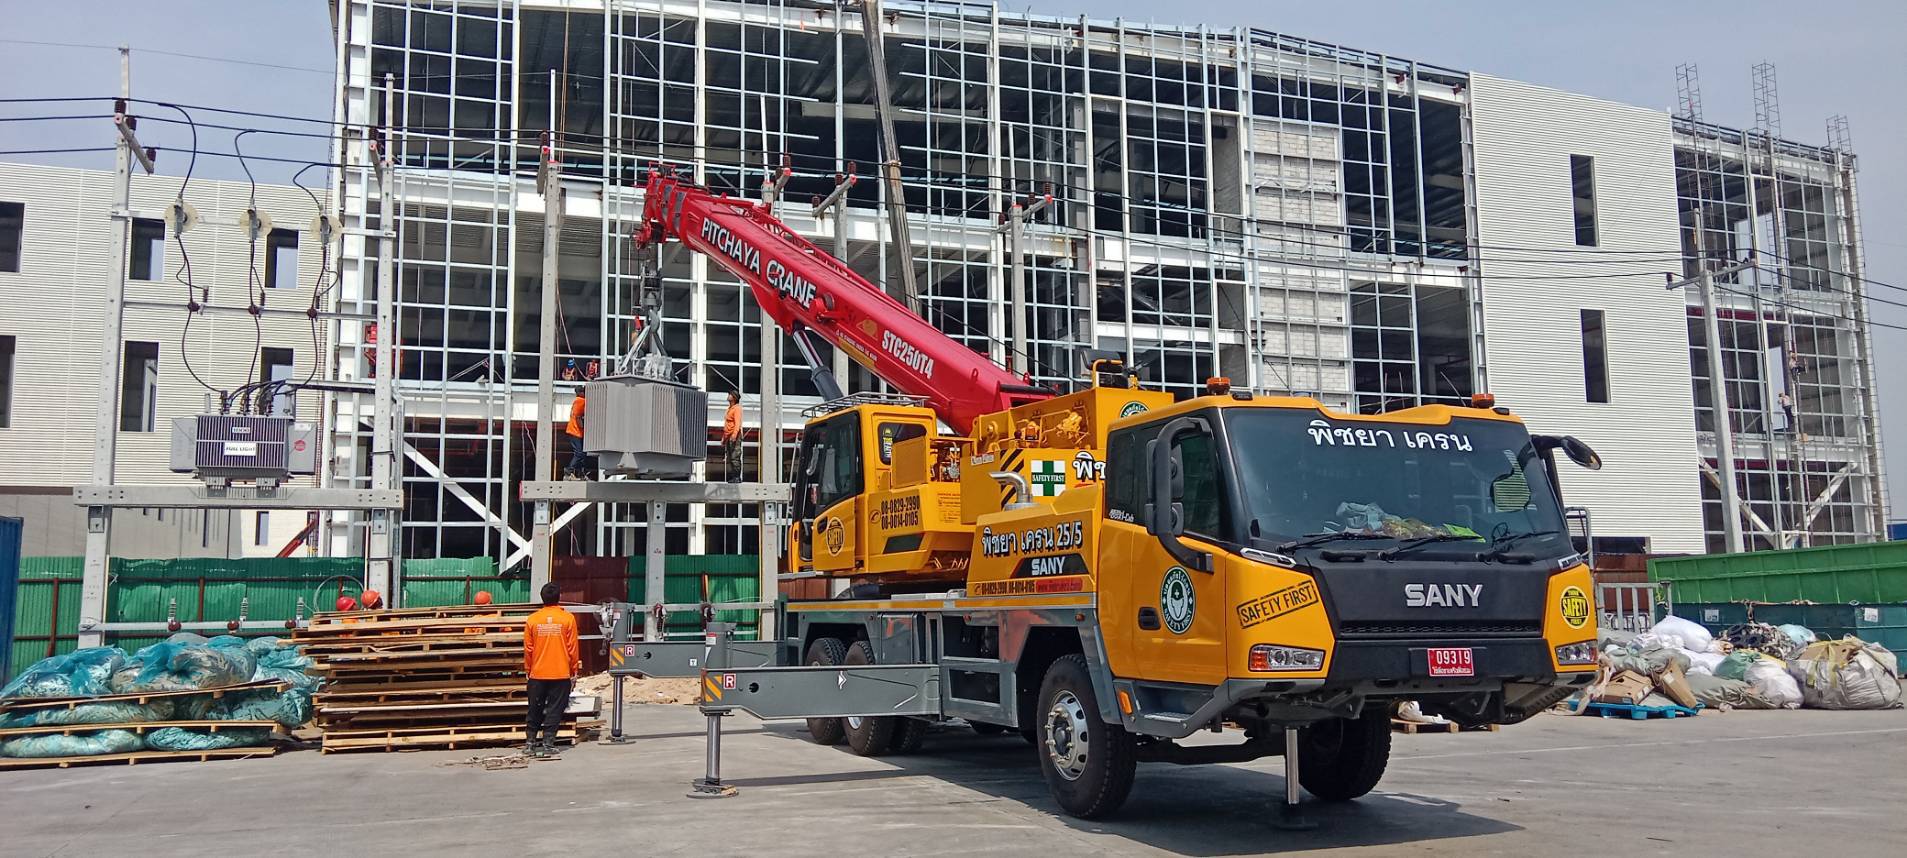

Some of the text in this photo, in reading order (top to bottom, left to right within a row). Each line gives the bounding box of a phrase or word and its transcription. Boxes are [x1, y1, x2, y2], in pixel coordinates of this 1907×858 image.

[701, 217, 816, 309] PITCHAYA CRANE
[881, 329, 934, 379] STC250T4
[1307, 419, 1473, 451] พิชยา เครน
[1032, 474, 1065, 482] SAFETY FIRST
[981, 521, 1083, 556] พิชยา เครน 25/5
[1031, 557, 1065, 576] SANY
[1240, 586, 1313, 623] SAFETY FIRST
[1404, 583, 1483, 607] SANY
[1562, 598, 1586, 617] SAFETY
[1436, 650, 1470, 664] 09319
[725, 675, 734, 687] R
